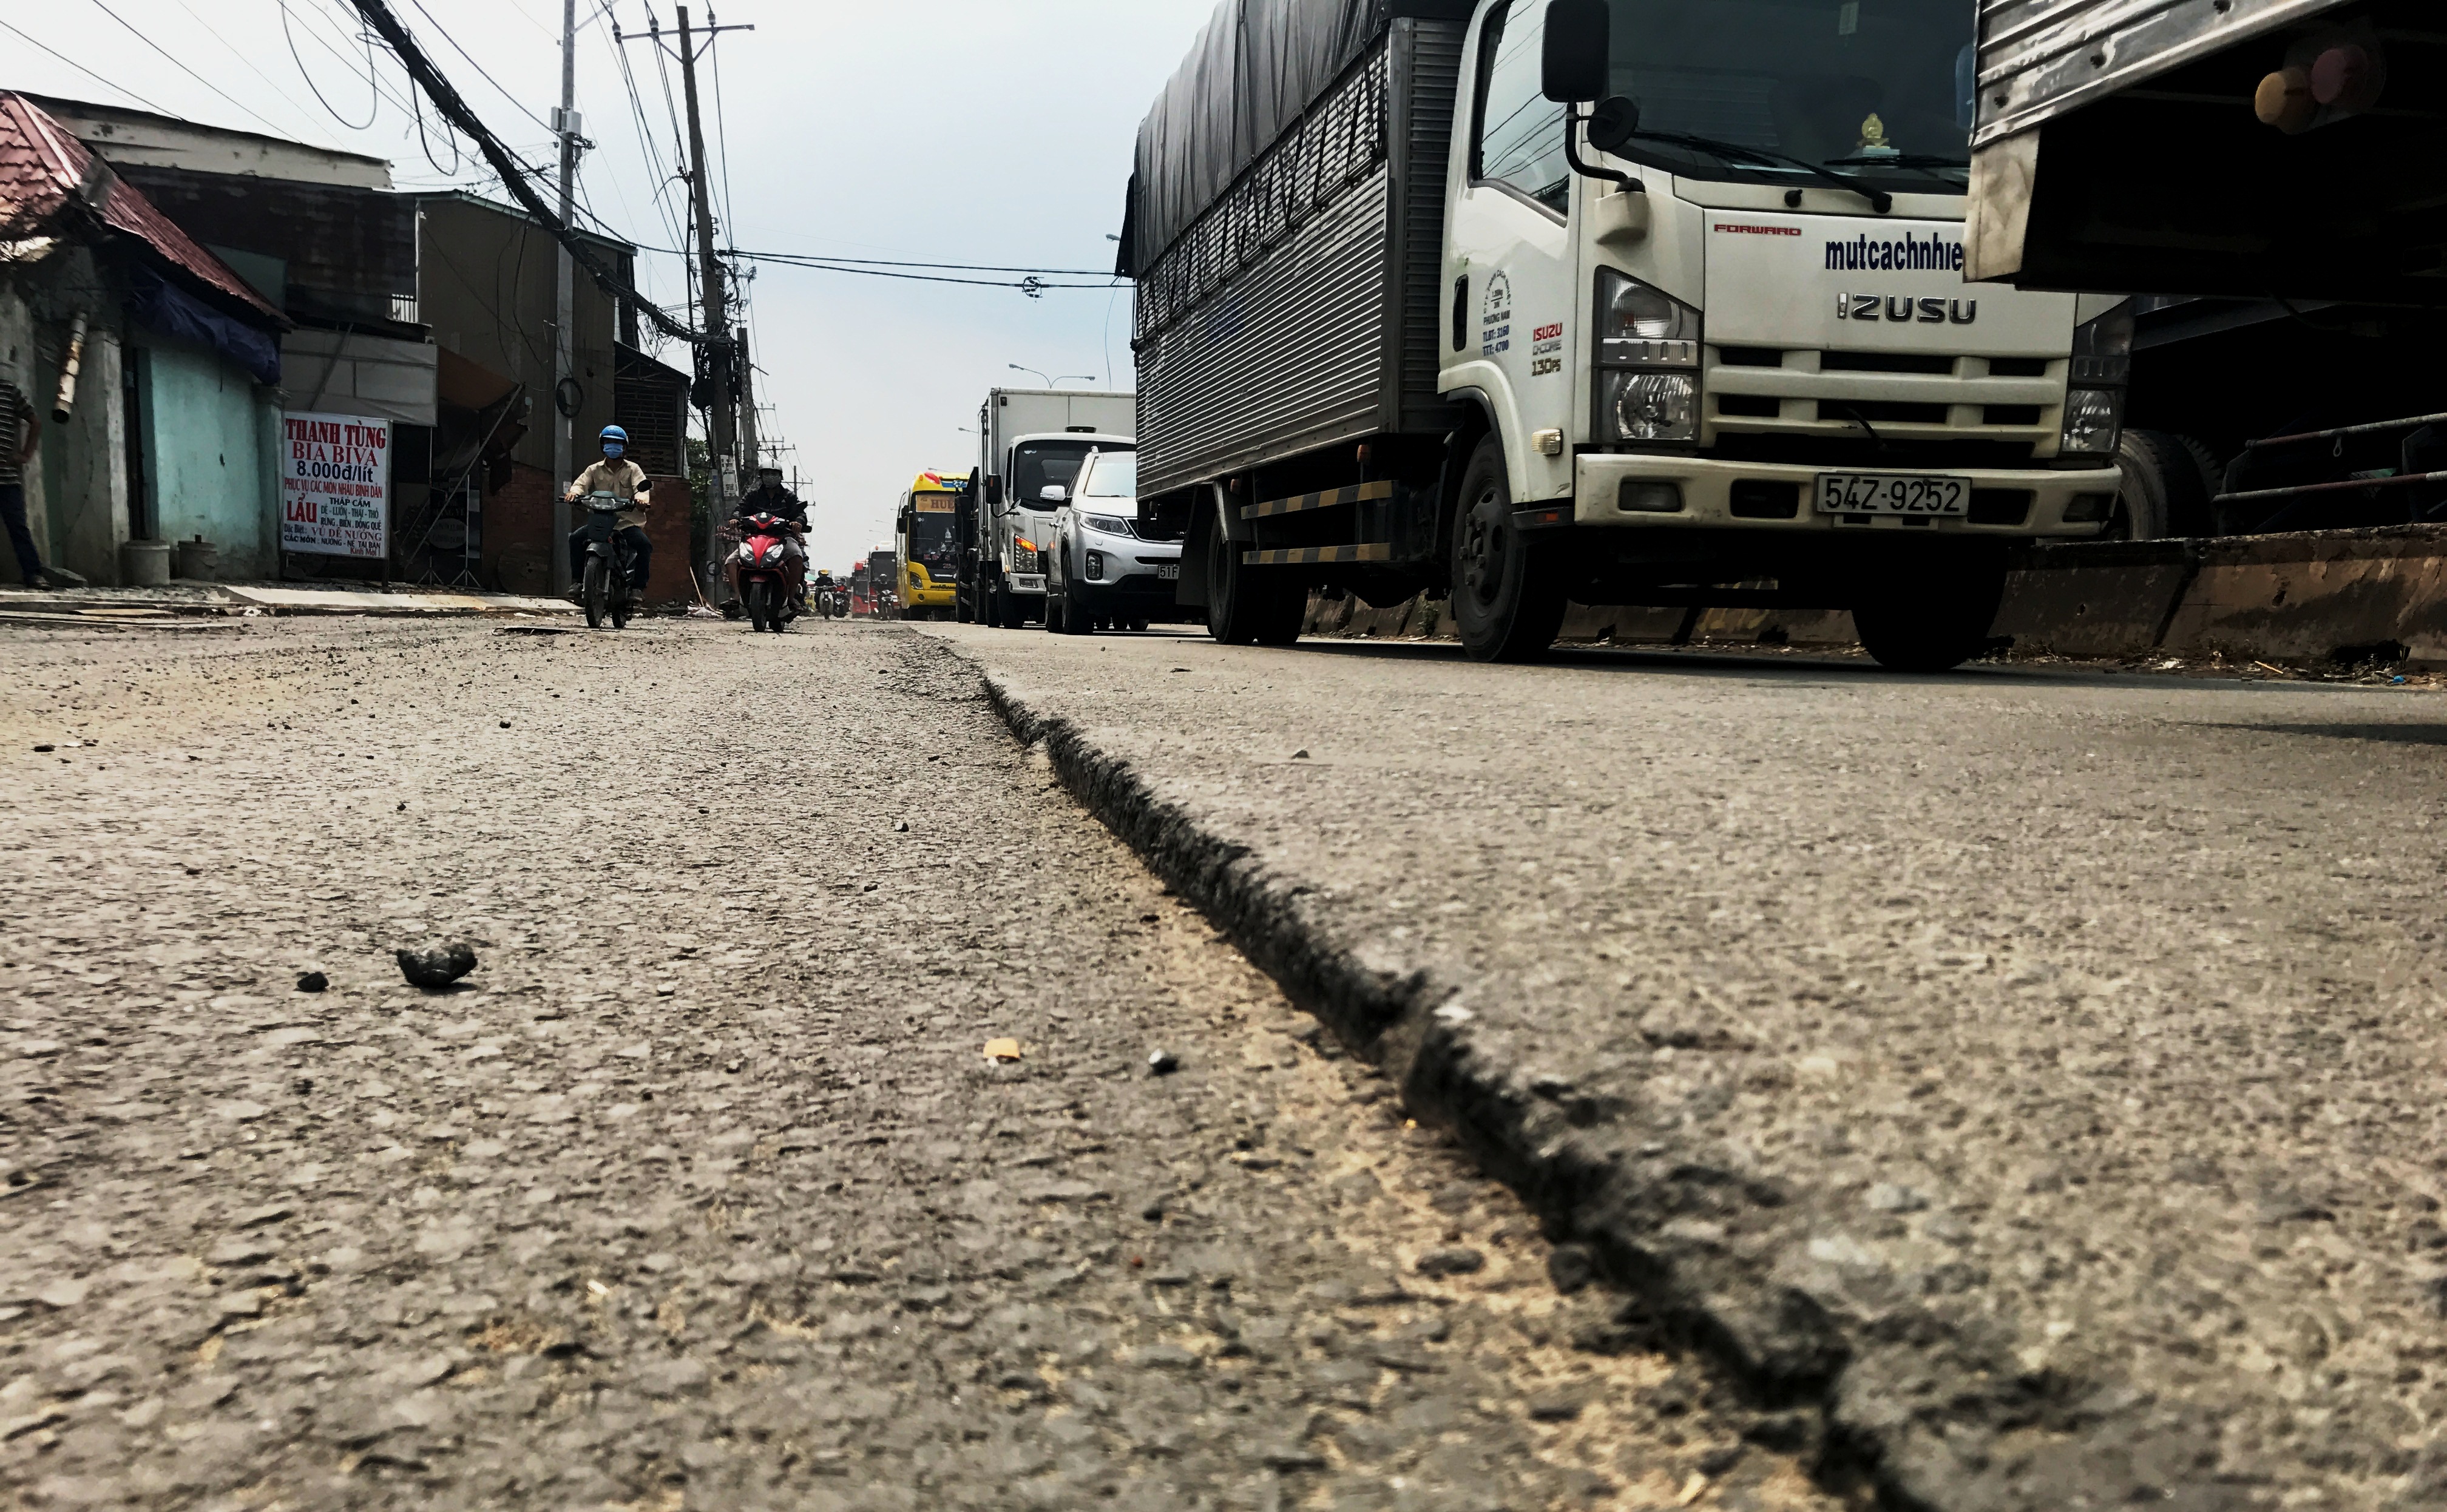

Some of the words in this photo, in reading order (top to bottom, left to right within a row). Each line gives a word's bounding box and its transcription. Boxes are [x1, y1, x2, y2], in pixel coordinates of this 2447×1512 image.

[1714, 224, 1802, 236] FORWARD
[1837, 292, 1977, 325] IZUSU
[1532, 322, 1563, 342] ISUZU
[1495, 339, 1509, 353] 4700
[285, 417, 341, 445] THANH
[344, 420, 387, 449] TÙNG
[291, 440, 327, 462] BIA
[332, 445, 379, 467] BIVA
[296, 460, 373, 483] 8.000đ/lít
[286, 492, 317, 523] LẨU
[1825, 478, 1961, 512] 54Z-9252
[1160, 566, 1178, 578] 51F
